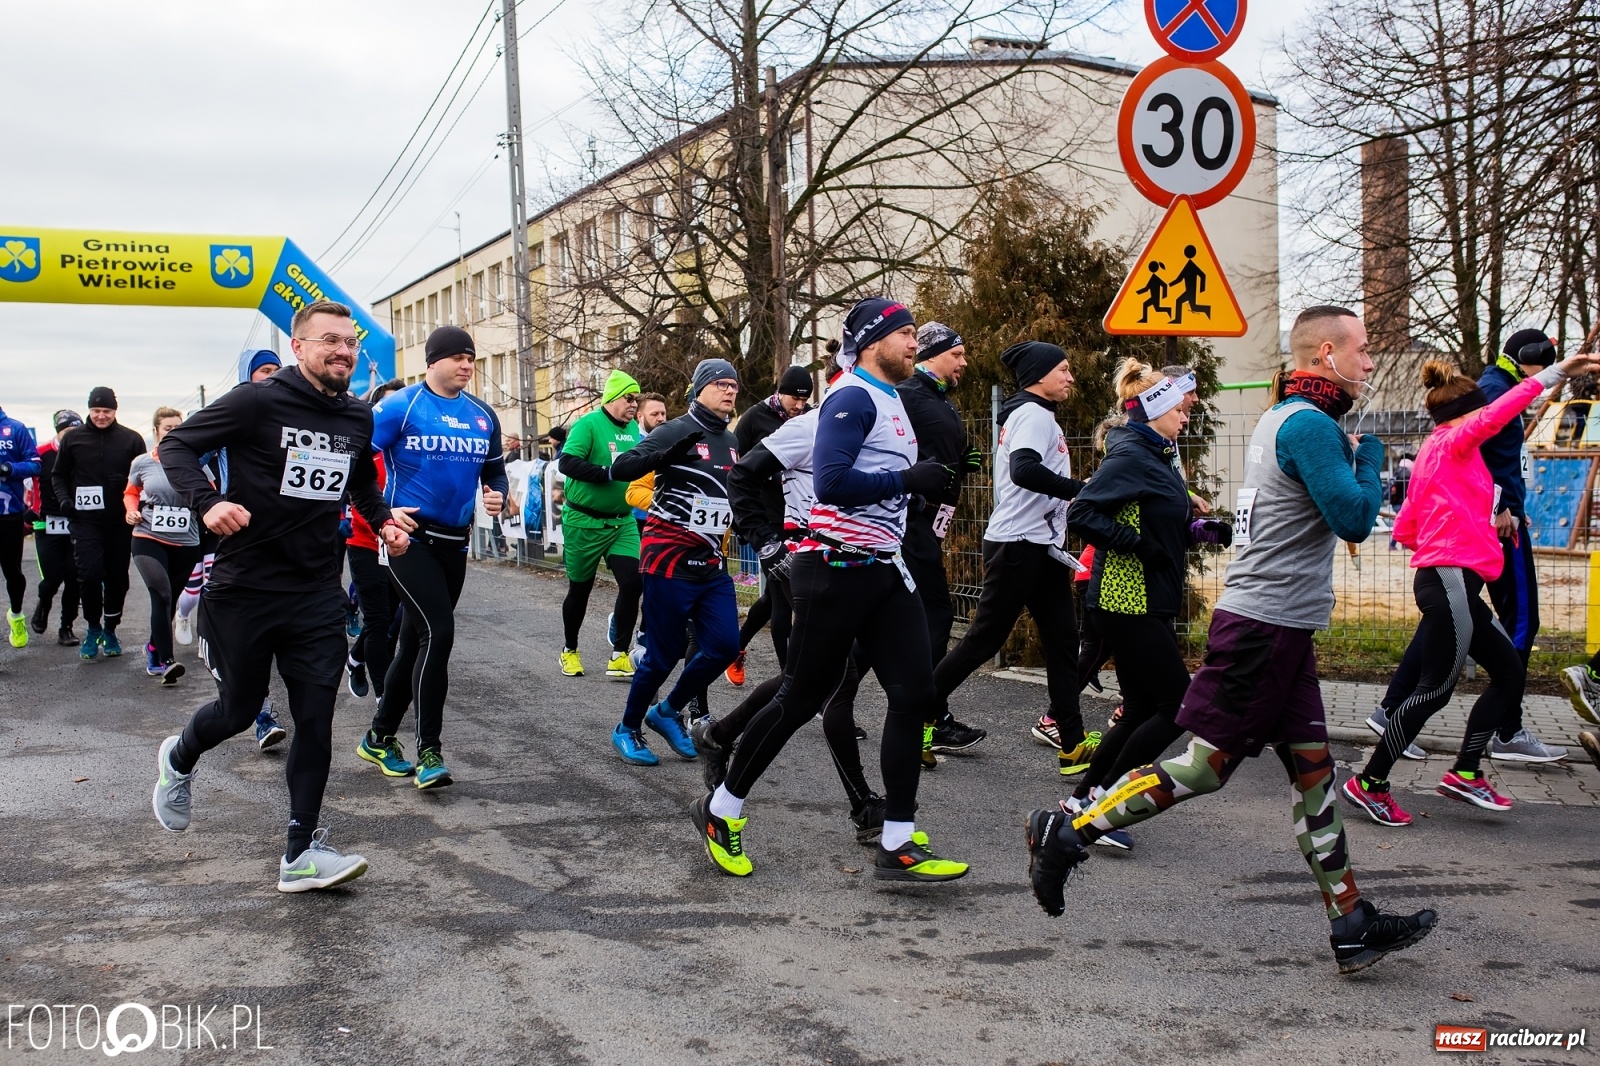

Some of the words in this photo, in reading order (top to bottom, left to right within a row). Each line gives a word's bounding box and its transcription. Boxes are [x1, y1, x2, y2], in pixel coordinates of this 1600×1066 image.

[1141, 92, 1234, 171] 30
[83, 239, 169, 254] Gmina
[61, 254, 193, 273] Pietrowice
[78, 273, 176, 290] Wielkie
[281, 427, 331, 450] FOB
[333, 435, 351, 444] FREE
[287, 466, 344, 492] 362
[77, 494, 101, 506] 320
[48, 520, 69, 530] 11
[154, 515, 187, 528] 269
[693, 509, 731, 528] 314
